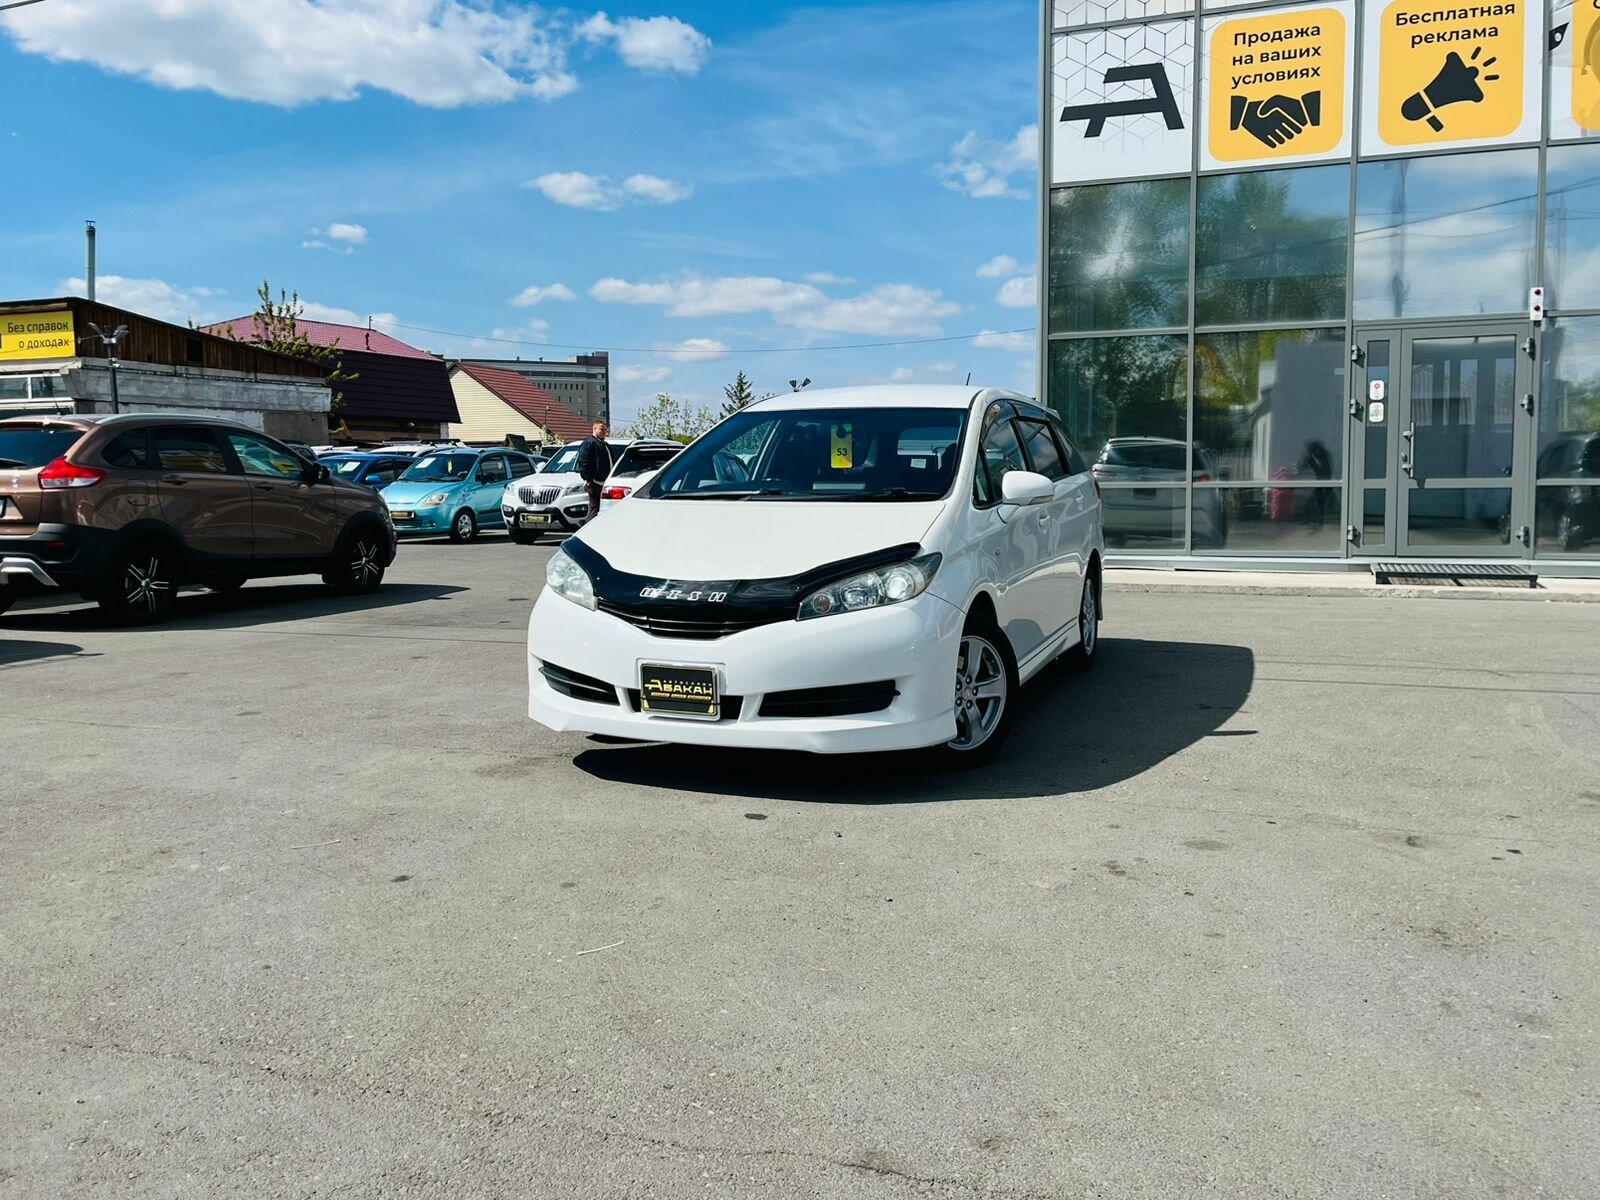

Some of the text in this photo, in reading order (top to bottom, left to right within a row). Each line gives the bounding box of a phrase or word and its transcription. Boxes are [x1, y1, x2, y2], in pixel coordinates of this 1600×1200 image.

[1395, 3, 1516, 26] Бесплатная
[1233, 25, 1321, 47] Продажа
[1410, 26, 1499, 48] реклама
[1232, 46, 1322, 66] на ваших
[1231, 66, 1321, 89] условиях
[7, 322, 69, 333] Без справок
[18, 338, 70, 350] о доходах
[836, 447, 848, 456] 53
